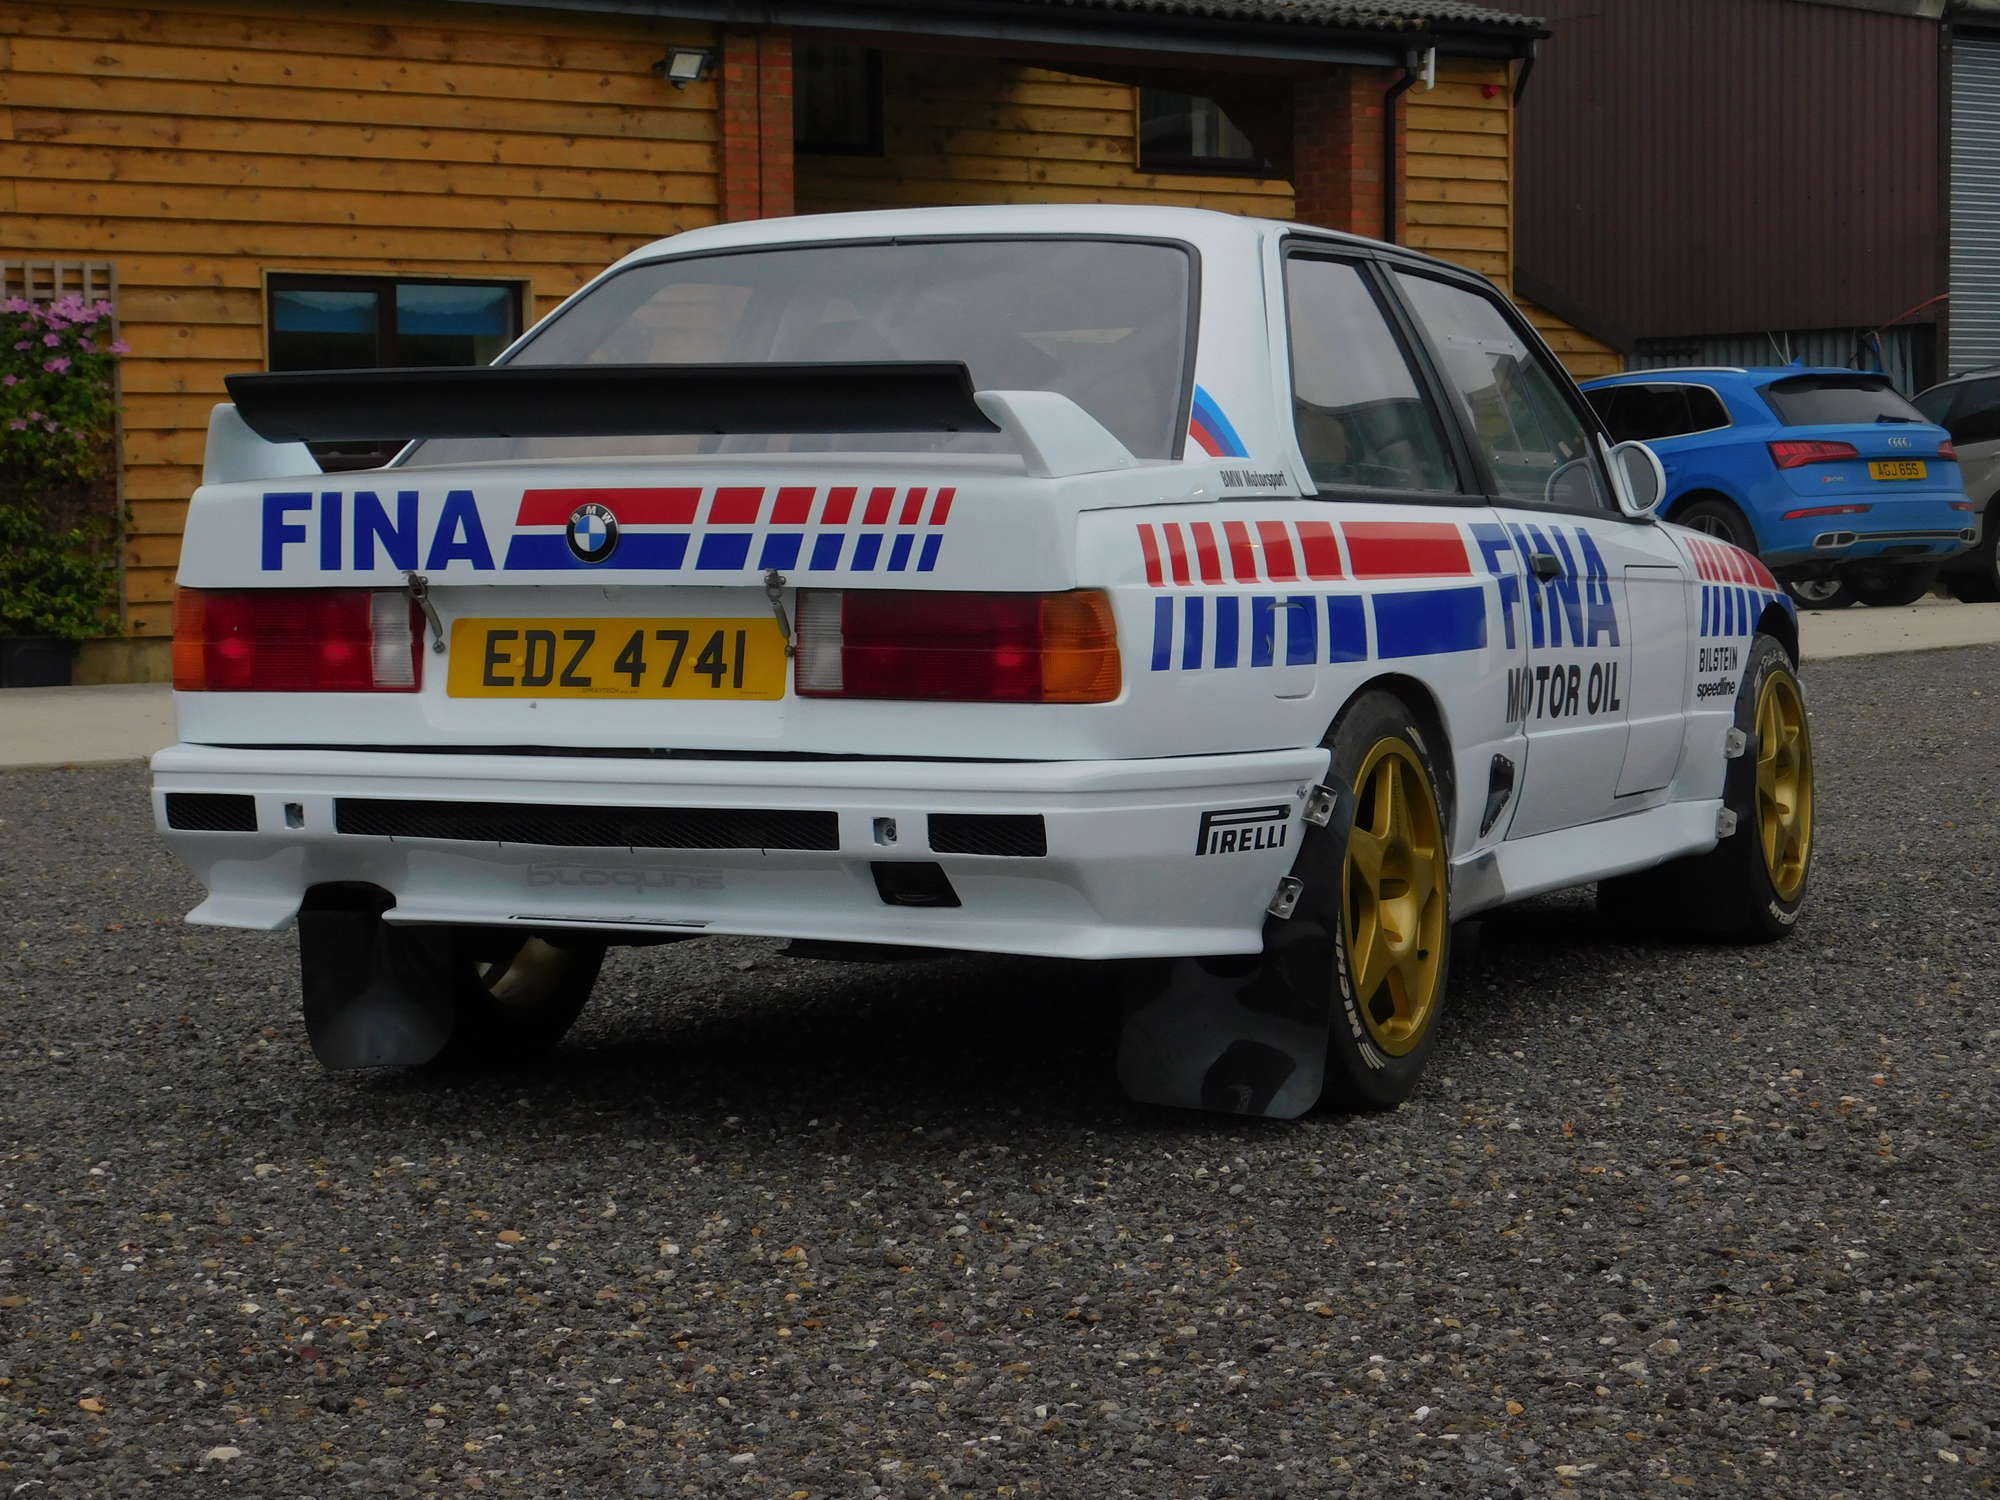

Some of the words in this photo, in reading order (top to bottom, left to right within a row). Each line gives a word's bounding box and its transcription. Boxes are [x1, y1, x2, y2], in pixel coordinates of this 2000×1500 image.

[1219, 470, 1243, 487] BMW
[1242, 470, 1287, 490] Motorsport
[261, 490, 496, 571] FINA
[571, 505, 613, 524] BMW
[1468, 523, 1620, 649] FINA
[482, 629, 596, 687] EDZ
[613, 629, 746, 688] 4741
[1698, 646, 1738, 672] BILSTEIN
[1506, 663, 1581, 724] MOTOR
[1587, 661, 1620, 716] OIL
[1697, 676, 1736, 701] speedline
[1195, 804, 1291, 856] PIRELLI
